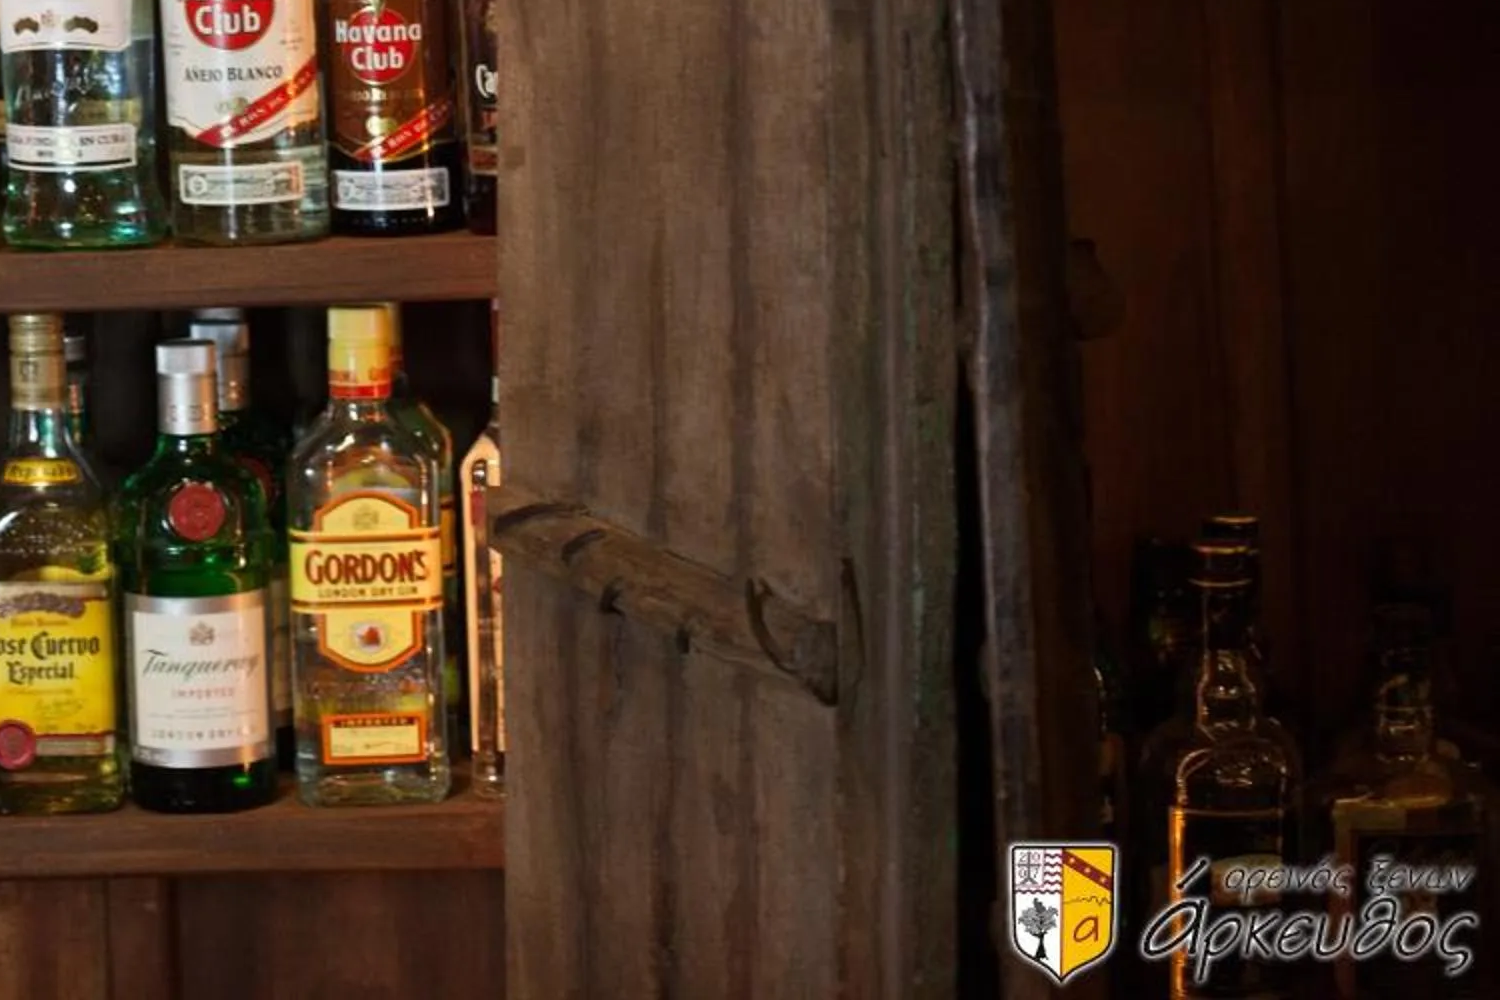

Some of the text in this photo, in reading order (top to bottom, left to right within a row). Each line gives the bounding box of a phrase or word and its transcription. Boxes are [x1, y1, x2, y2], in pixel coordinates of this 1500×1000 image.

[195, 3, 261, 36] Club
[334, 18, 423, 44] Havana
[351, 46, 405, 71] Club
[226, 64, 284, 82] BLANCO
[304, 548, 430, 586] GORDON'S
[30, 629, 101, 660] Cuervo
[6, 661, 75, 686] Especial
[141, 648, 261, 682] Tanqueray
